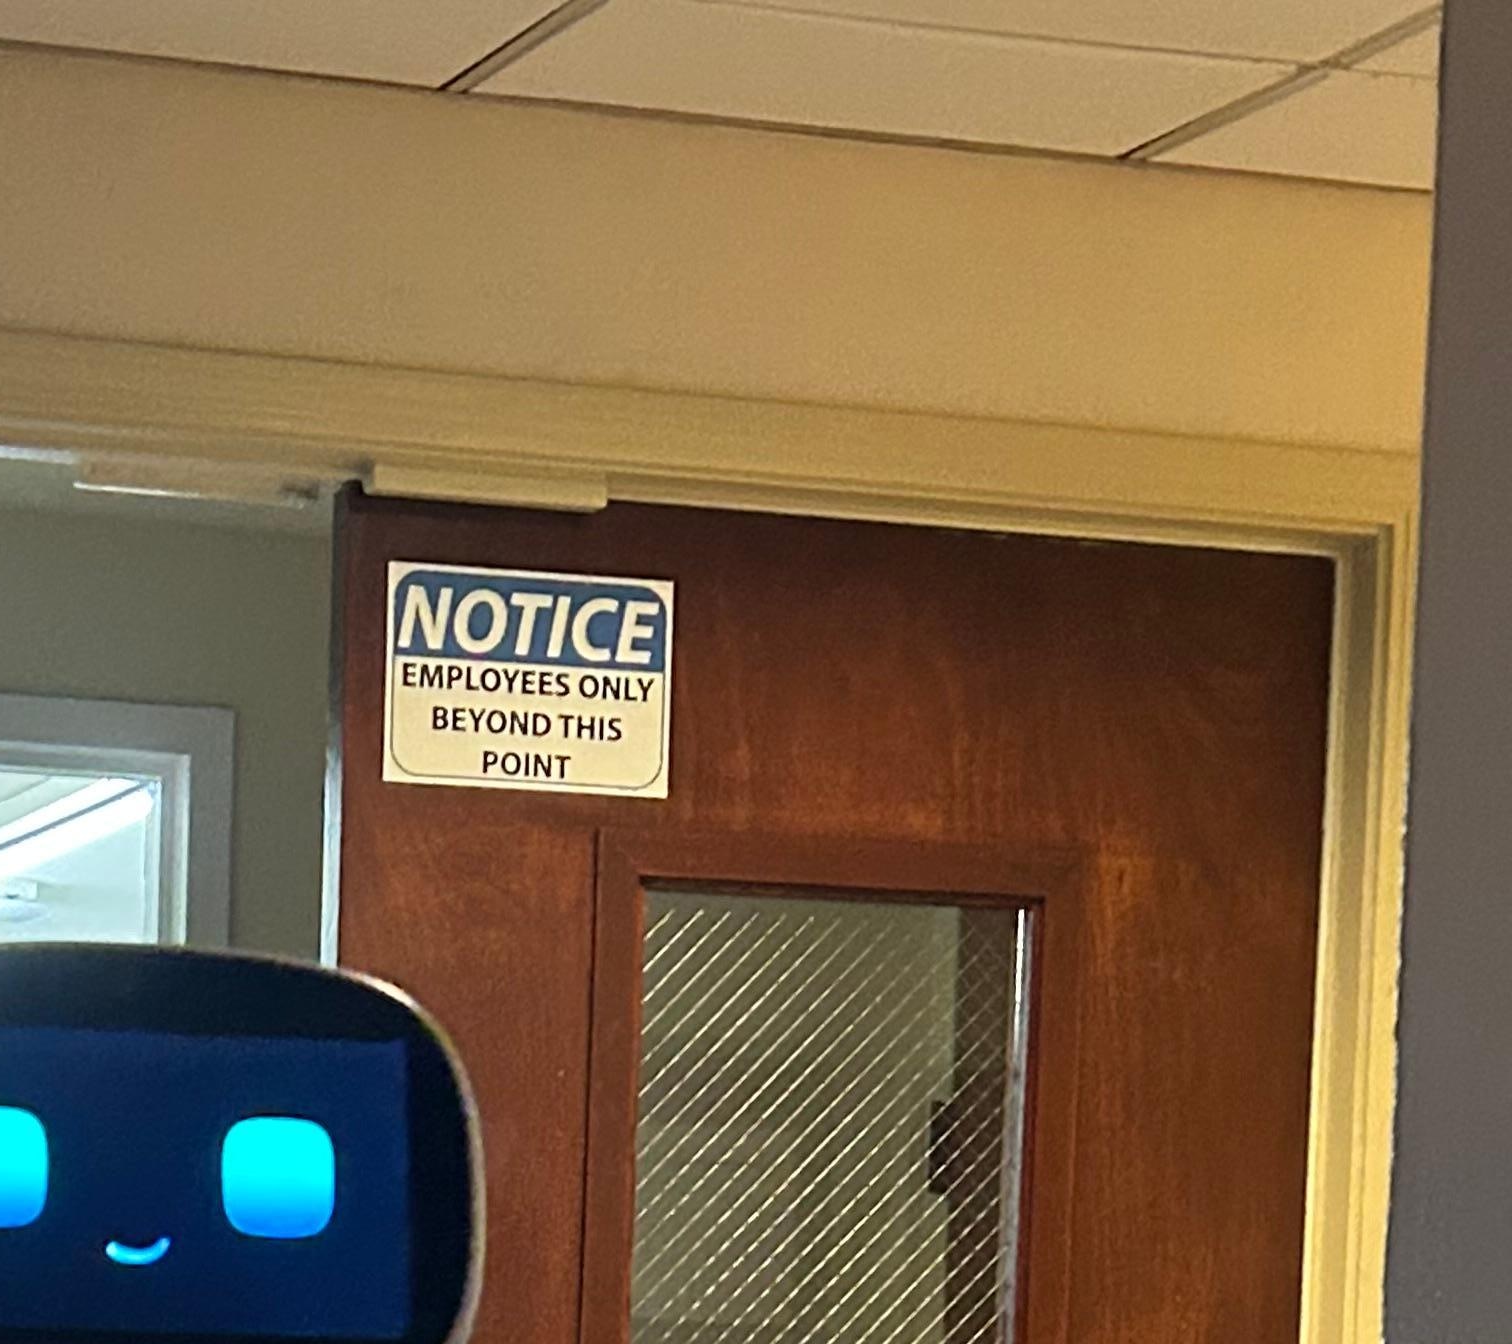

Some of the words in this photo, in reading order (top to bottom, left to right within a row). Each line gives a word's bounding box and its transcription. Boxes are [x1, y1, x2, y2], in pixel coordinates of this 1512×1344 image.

[397, 584, 660, 665] NOTICE
[401, 662, 571, 697] EMPLOYEES
[578, 674, 655, 702] ONLY
[431, 706, 553, 737] BEYOND
[557, 714, 623, 741] THIS
[481, 751, 572, 779] POINT
